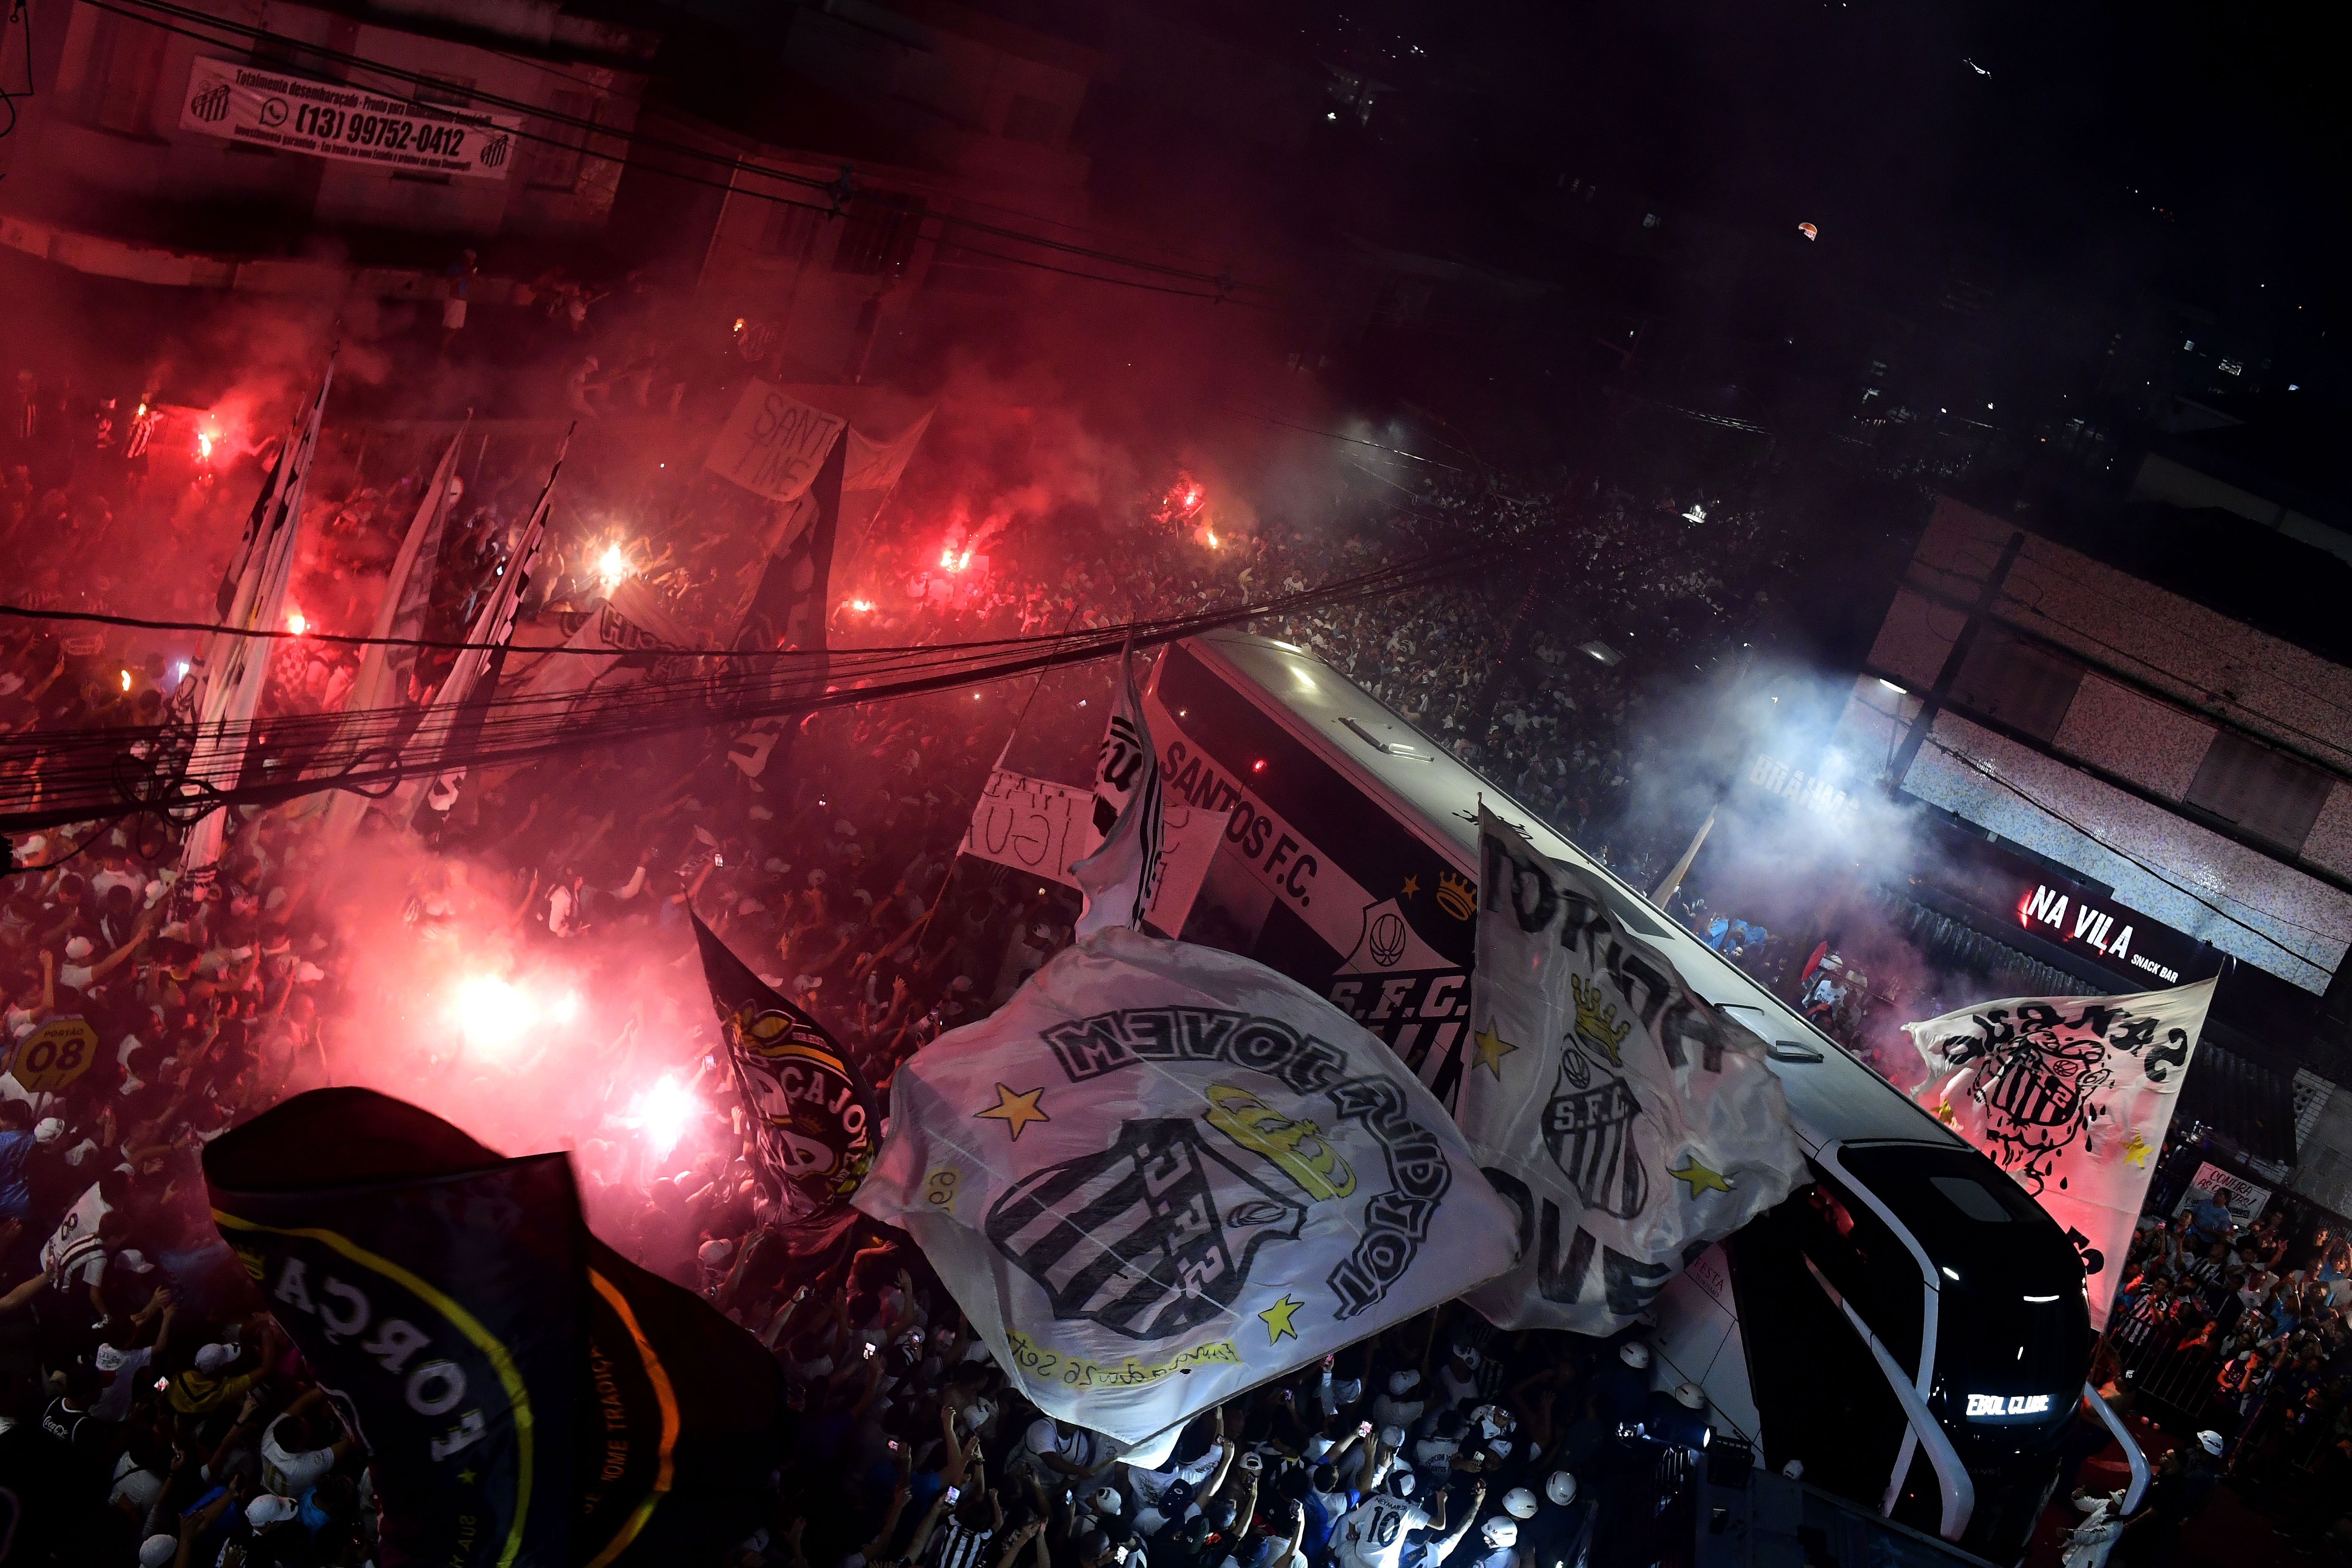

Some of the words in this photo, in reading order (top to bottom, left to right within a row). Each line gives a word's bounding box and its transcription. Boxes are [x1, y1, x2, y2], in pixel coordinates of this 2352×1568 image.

[236, 68, 289, 94] Totalmente
[296, 103, 346, 139] (13)
[346, 113, 465, 157] 99752-0412
[1160, 742, 1272, 858] SANTOS
[1263, 840, 1318, 907] F.C.
[2028, 884, 2069, 929] NA
[2074, 904, 2133, 959] VILA
[2131, 954, 2161, 975] SNACK
[2159, 966, 2179, 984] BAR
[26, 1038, 85, 1073] 08
[2197, 1179, 2212, 1190] AS
[2210, 1170, 2253, 1196] CONFIRA
[1694, 1257, 1723, 1291] FESTA
[599, 1438, 629, 1482] NOME
[1375, 1497, 1400, 1511] NEYMAR
[1366, 1506, 1401, 1547] 10
